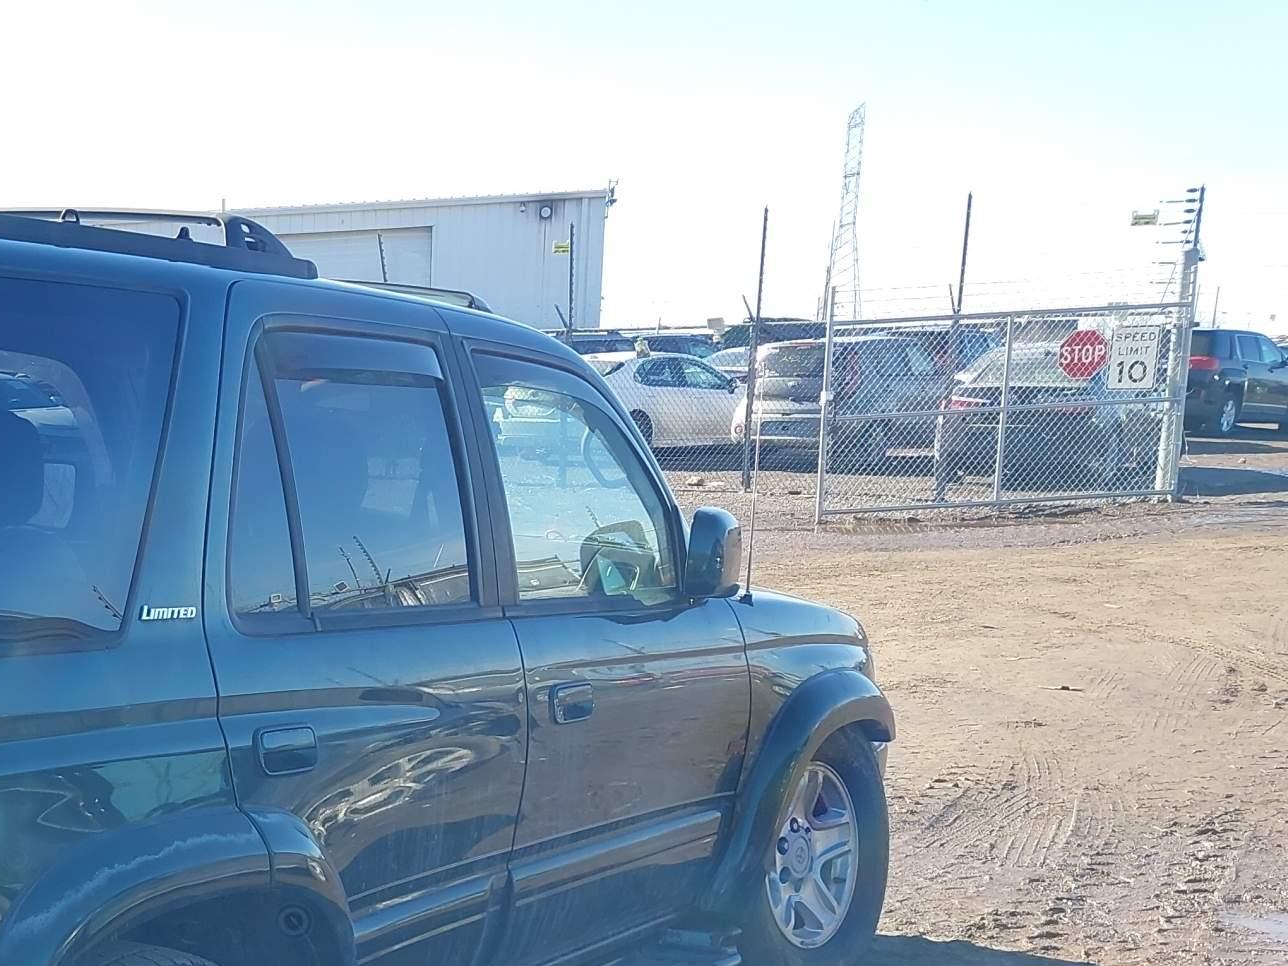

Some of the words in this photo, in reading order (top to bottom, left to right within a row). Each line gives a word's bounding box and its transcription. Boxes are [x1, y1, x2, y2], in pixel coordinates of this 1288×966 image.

[1115, 331, 1157, 342] SPEED
[1061, 345, 1106, 364] STOP
[1118, 346, 1150, 356] LIMIT
[1116, 360, 1148, 384] 10
[141, 605, 197, 620] LIMITED
